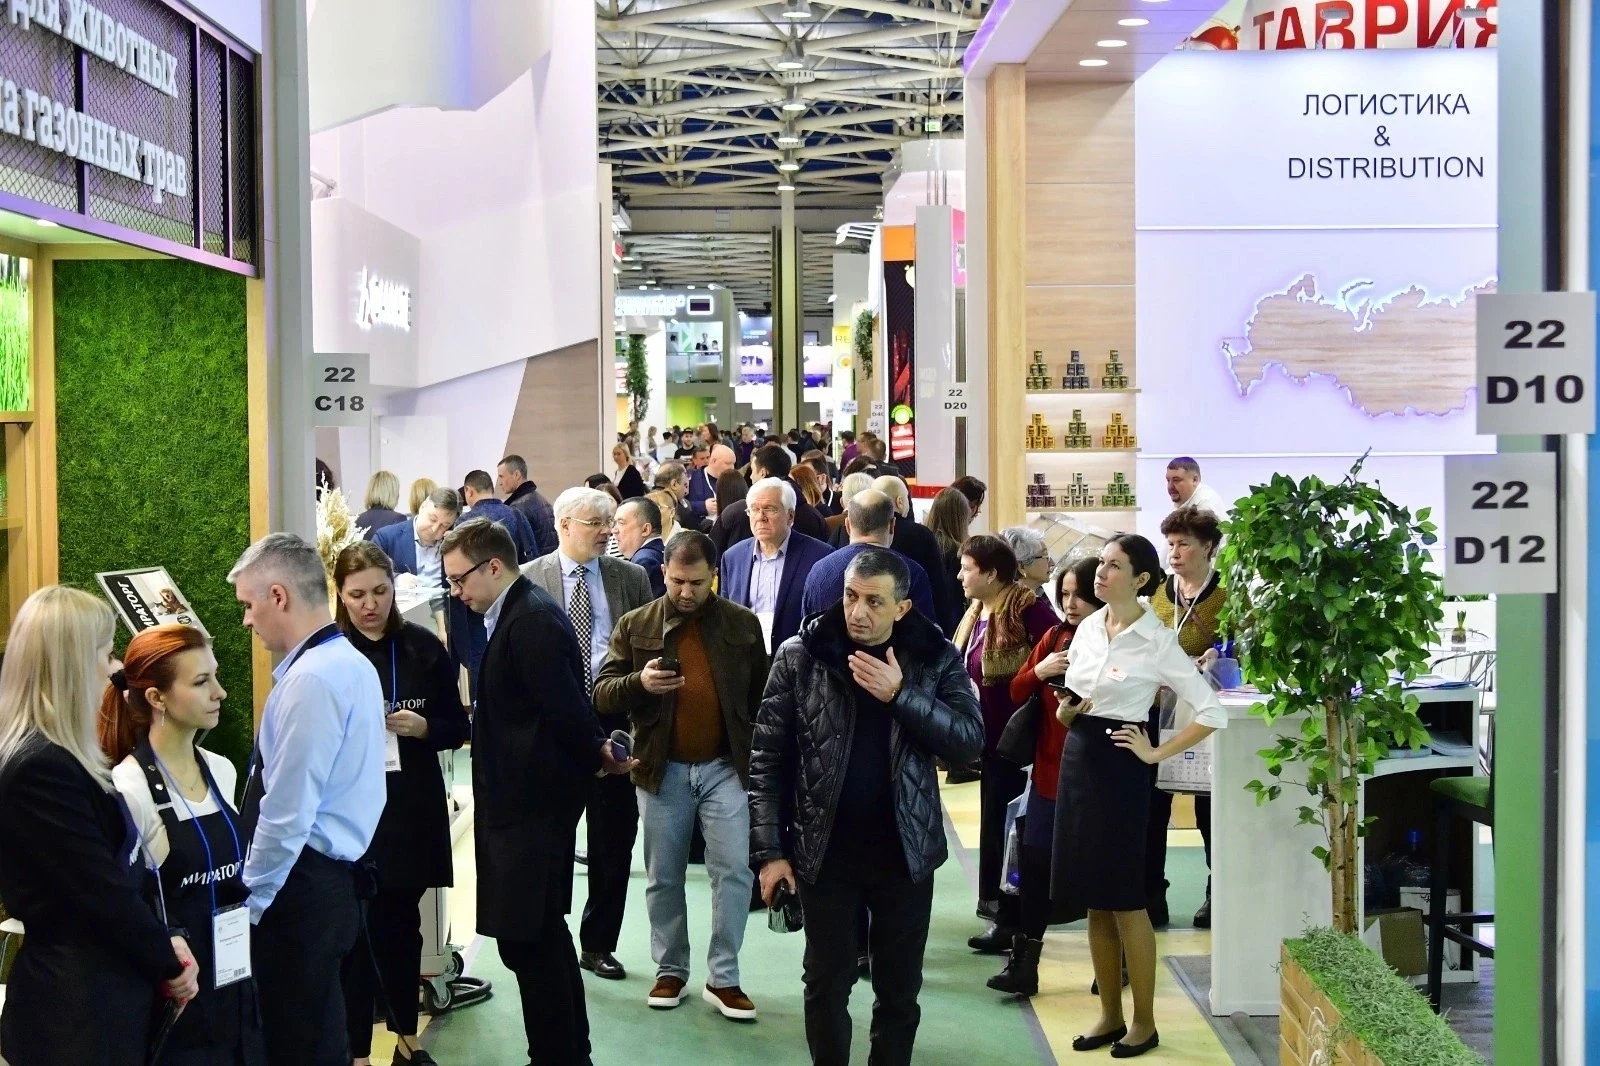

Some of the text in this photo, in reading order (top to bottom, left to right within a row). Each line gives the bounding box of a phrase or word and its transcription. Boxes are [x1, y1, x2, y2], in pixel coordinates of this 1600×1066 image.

[64, 0, 178, 98] животных
[1303, 93, 1470, 116] ЛОГИСТИКА
[22, 88, 143, 181] газонных
[139, 139, 187, 204] трав
[1373, 125, 1391, 147] &
[1288, 155, 1484, 179] DISTRIBUTION
[1503, 319, 1566, 349] 22
[324, 366, 356, 383] 22
[948, 388, 963, 397] 22
[1486, 374, 1584, 404] D10
[314, 395, 365, 412] C18
[944, 402, 967, 410] D20
[1471, 480, 1529, 510] 22
[1454, 534, 1546, 565] D12
